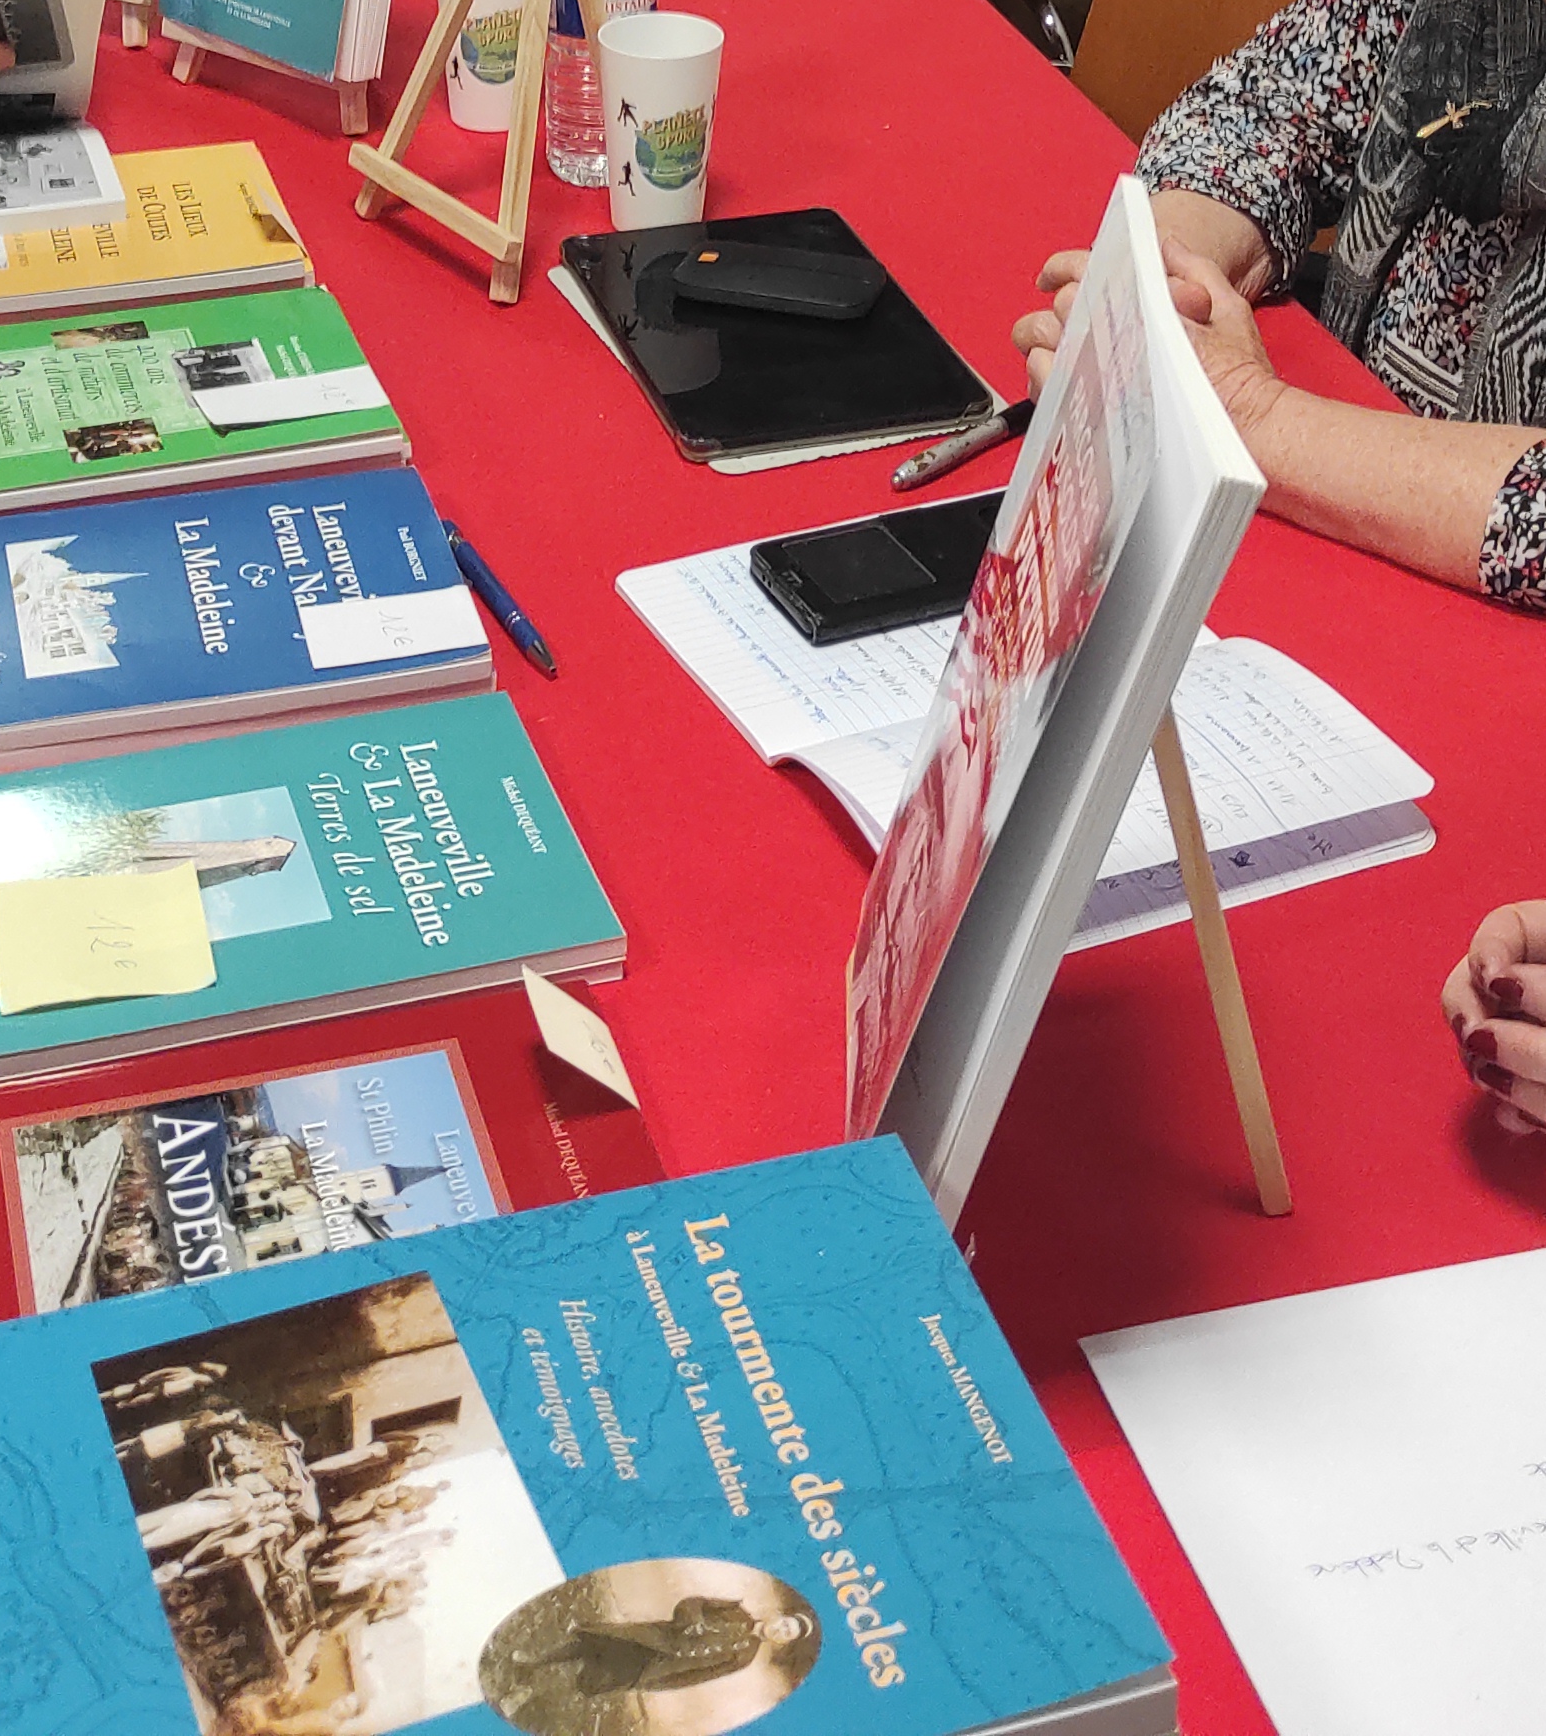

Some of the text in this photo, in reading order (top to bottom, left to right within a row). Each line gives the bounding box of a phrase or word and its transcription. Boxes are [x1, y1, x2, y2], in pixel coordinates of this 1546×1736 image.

[466, 7, 523, 33] PLANÈT
[136, 185, 159, 202] DE
[171, 181, 196, 202] LES
[73, 352, 106, 402] de métiers
[105, 347, 139, 359] de
[146, 367, 167, 386] ans
[238, 561, 276, 589] &
[267, 503, 311, 571] devant
[311, 501, 373, 603] Laneuvev
[397, 526, 413, 544] Paul
[174, 514, 237, 656] La Madeleine
[305, 771, 397, 918] Terres de sel
[348, 740, 453, 949] & La Madeleine
[398, 738, 497, 899] Laneuveville
[499, 774, 549, 856] Michel DEQUÉANT
[299, 1119, 329, 1151] La
[356, 1075, 400, 1156] St Phlin
[543, 1100, 591, 1200] Michel DEQUÉAN
[152, 1113, 233, 1285] ANDÉS
[433, 1127, 480, 1224] Laneuvev
[520, 1326, 587, 1471] et témoignages
[557, 1298, 640, 1483] Histoire, anecdotes
[624, 1229, 751, 1520] à Laneuveville & La Madeleine
[918, 1312, 1014, 1465] Jacques MANGENOT
[683, 1212, 908, 1690] La tourmente des siècles
